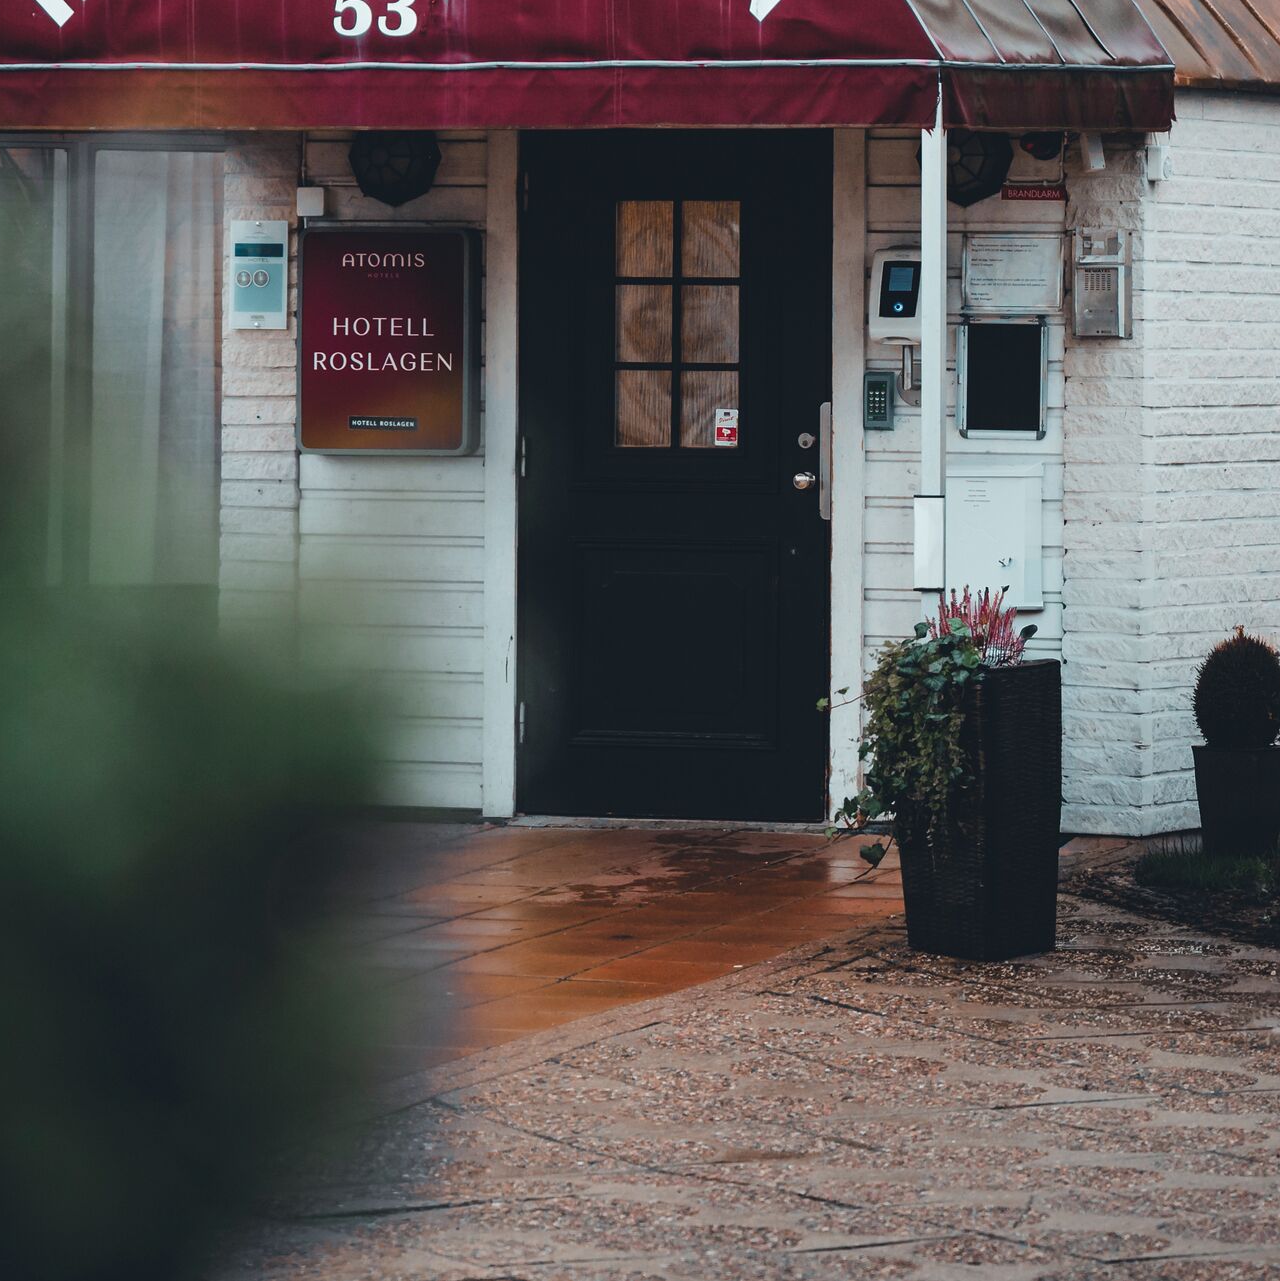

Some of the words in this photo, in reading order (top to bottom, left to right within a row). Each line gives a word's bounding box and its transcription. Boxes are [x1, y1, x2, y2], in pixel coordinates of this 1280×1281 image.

[1007, 189, 1061, 199] BRANDLARM
[341, 252, 426, 269] ATOMIS
[332, 317, 435, 337] HOTELL
[313, 351, 454, 372] ROSLAGEN
[351, 419, 378, 427] HOTELL
[379, 420, 416, 428] ROSLAGEN
